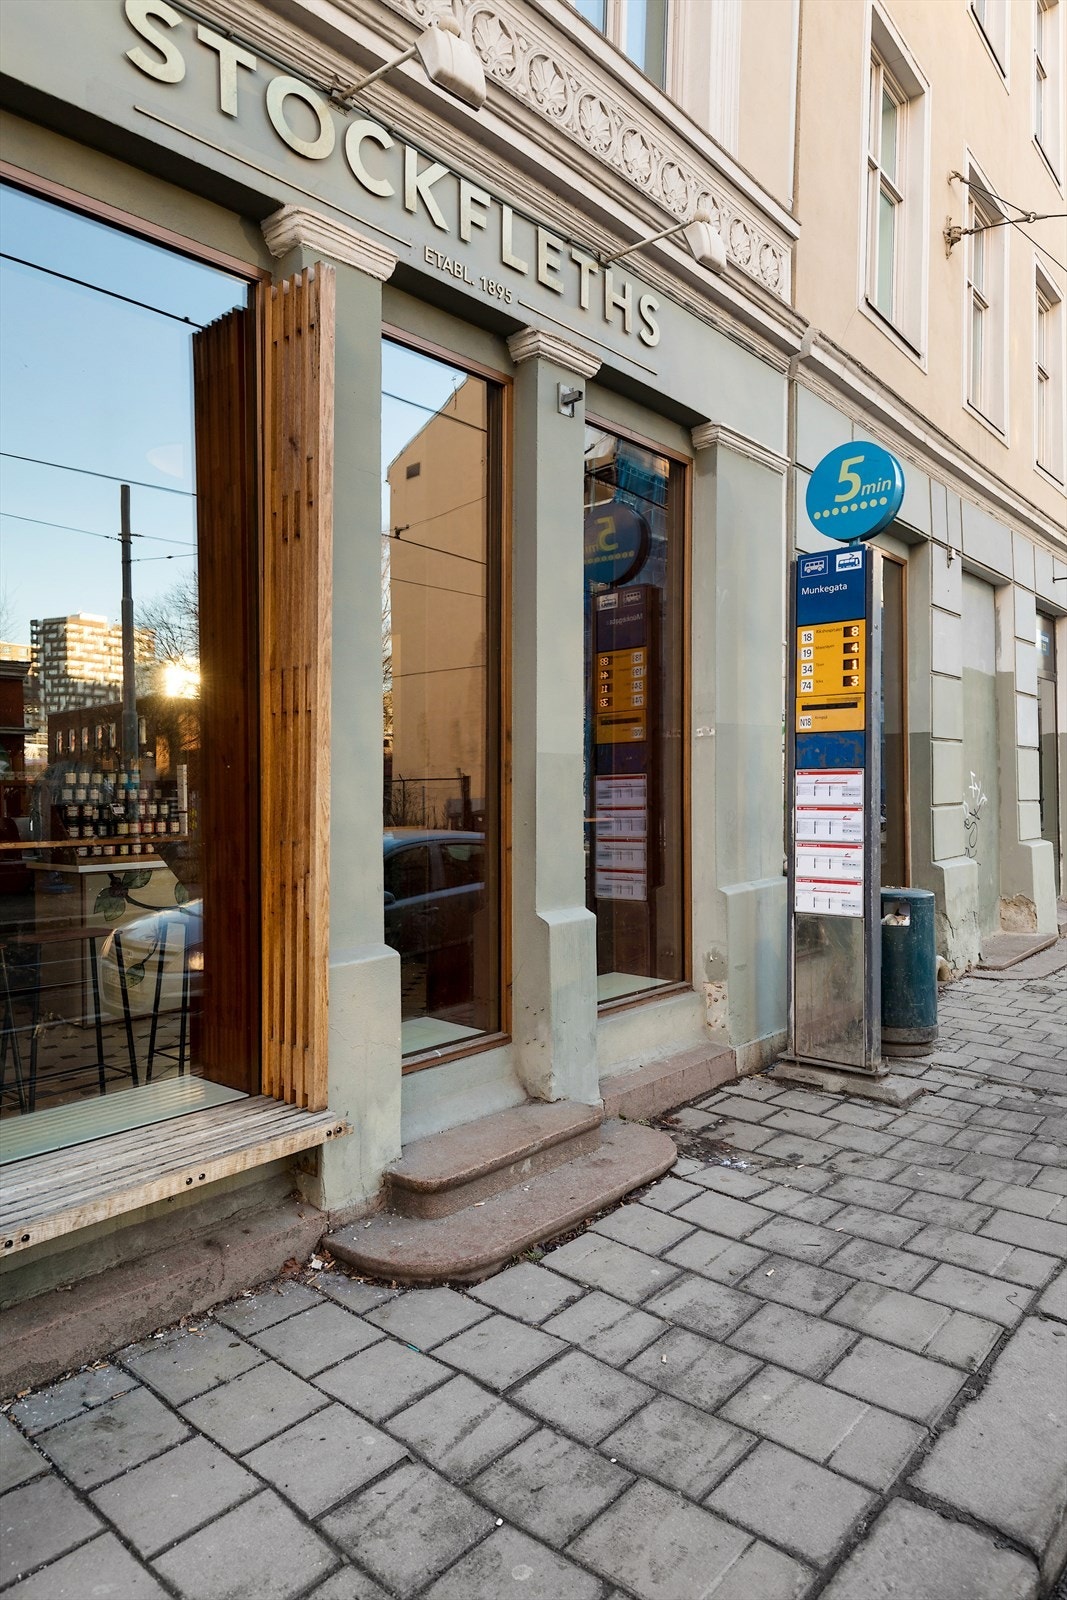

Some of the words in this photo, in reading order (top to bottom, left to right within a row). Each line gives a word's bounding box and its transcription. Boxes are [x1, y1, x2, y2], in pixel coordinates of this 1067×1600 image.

[124, 0, 662, 348] STOCKFLETHS
[424, 245, 475, 286] ETABL.
[479, 275, 513, 304] 1895
[834, 455, 865, 503] 5
[861, 478, 892, 496] min
[802, 583, 848, 595] Munkegata
[851, 626, 859, 636] 8
[803, 632, 812, 642] 18
[851, 643, 859, 653] 4
[803, 649, 812, 658] 19
[802, 665, 812, 674] 34
[852, 659, 858, 670] 1
[802, 682, 812, 690] 74
[850, 676, 859, 686] 3
[800, 717, 812, 727] N18
